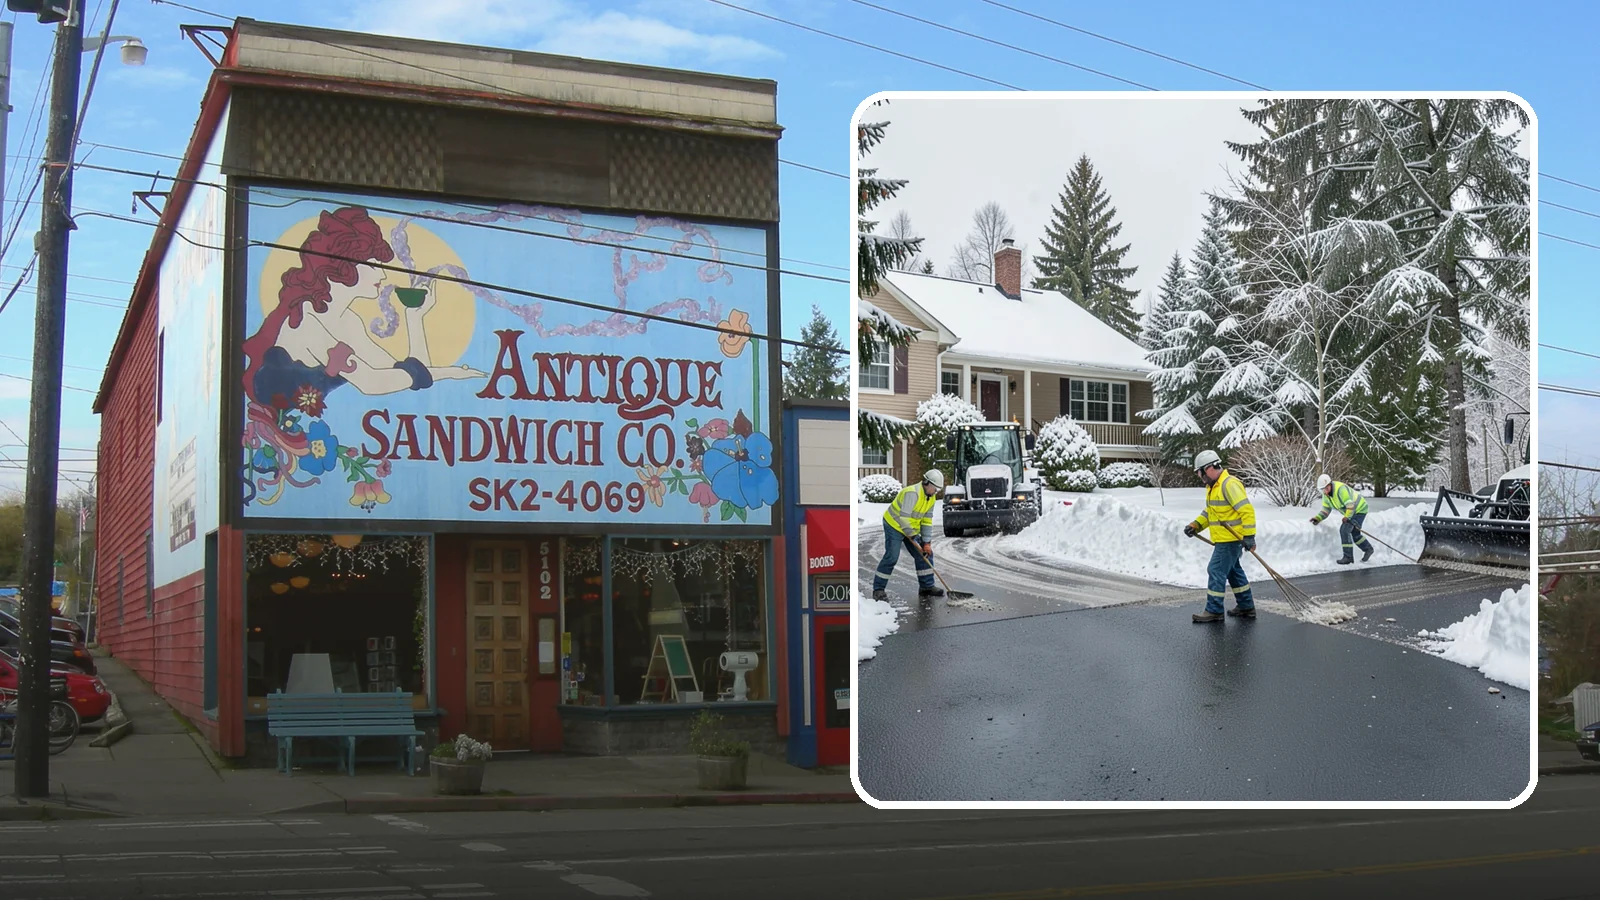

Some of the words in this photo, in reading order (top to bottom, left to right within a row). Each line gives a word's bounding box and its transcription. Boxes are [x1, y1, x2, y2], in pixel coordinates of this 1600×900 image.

[476, 329, 723, 420] ANTIQUE
[361, 408, 604, 467] SANDWICH
[617, 422, 685, 468] CO.
[468, 478, 645, 512] SK2-4069
[539, 542, 551, 599] 5102
[809, 555, 835, 568] BOOKS
